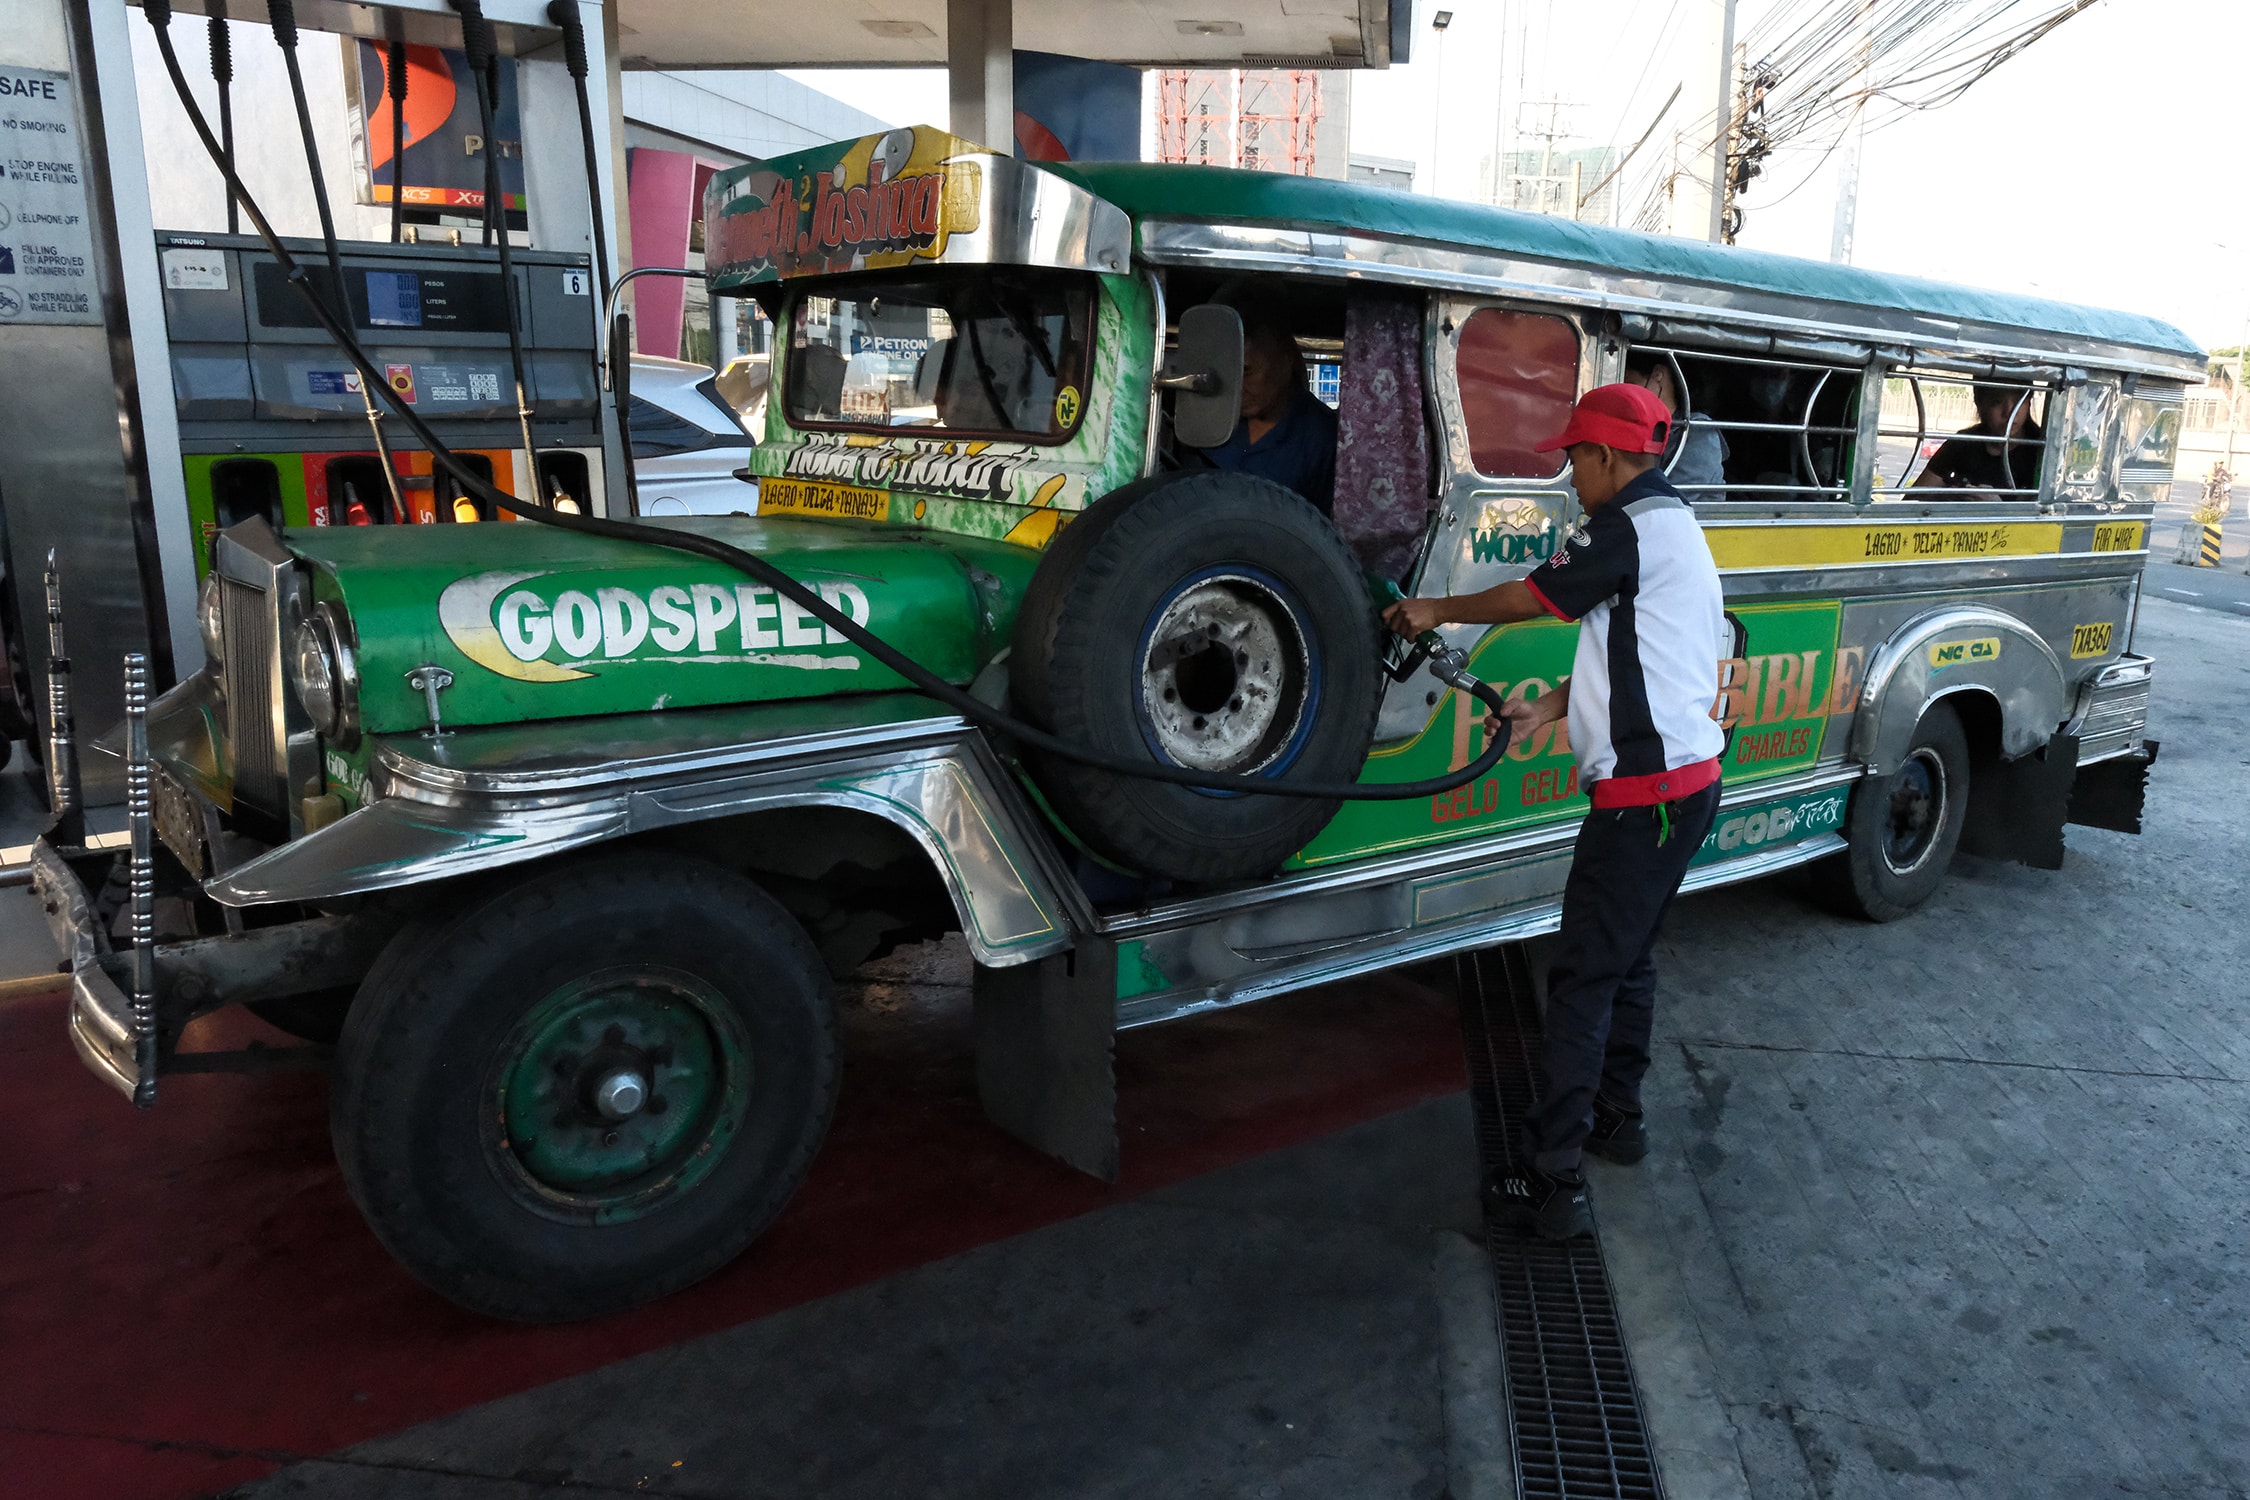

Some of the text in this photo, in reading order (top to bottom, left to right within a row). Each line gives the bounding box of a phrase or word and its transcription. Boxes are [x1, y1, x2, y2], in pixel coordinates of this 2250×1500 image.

[0, 76, 57, 100] SAFE
[3, 119, 67, 134] NO SMOKING
[9, 159, 74, 173] STOP ENGINE
[11, 171, 78, 184] WHILE FILLING
[797, 159, 946, 256] Joshua
[17, 213, 79, 225] CELLPHONE OFF
[169, 237, 206, 246] TATSUNO
[22, 245, 58, 256] FILLING
[38, 256, 84, 267] APPROVED
[25, 266, 85, 277] CONTAINERS ONLY
[571, 275, 580, 294] 6
[28, 292, 88, 303] NO STRADDLING
[30, 303, 88, 313] WHILE FILLING
[874, 338, 928, 351] PETRON
[1469, 525, 1556, 564] Word
[1951, 531, 1989, 553] PANAY
[2094, 527, 2135, 551] FOR HIRE
[499, 580, 870, 662] GODSPEED
[2071, 624, 2112, 655] TXA360
[1708, 646, 1864, 730] BIBLE
[1431, 777, 1499, 823] GELO
[1736, 727, 1811, 765] CHARLES
[1717, 806, 1791, 851] GOD
